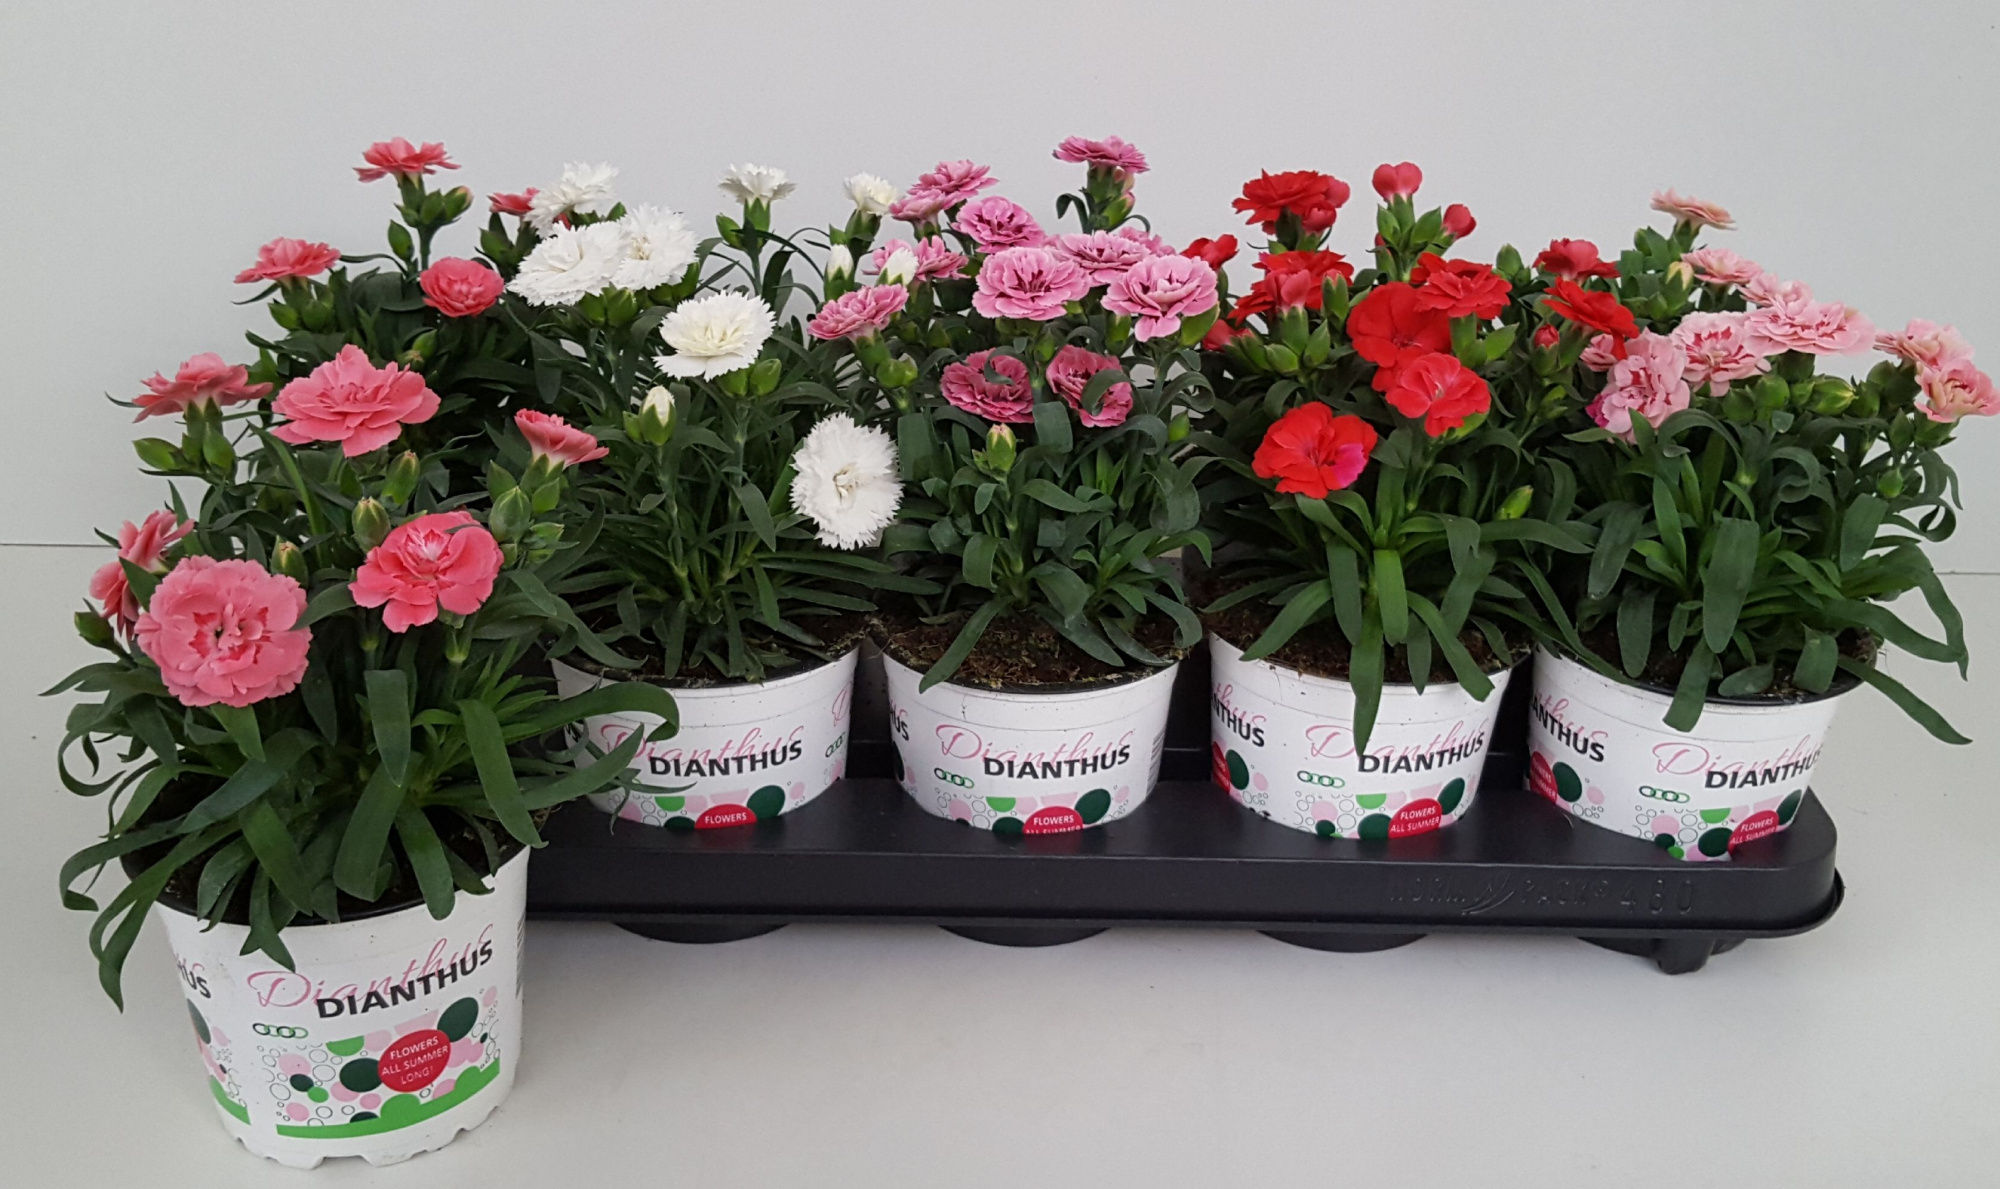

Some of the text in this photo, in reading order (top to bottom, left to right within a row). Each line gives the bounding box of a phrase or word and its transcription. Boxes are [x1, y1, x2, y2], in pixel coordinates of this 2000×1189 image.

[1212, 694, 1265, 748] NTHUS
[1531, 696, 1605, 763] ANTHUS
[935, 724, 1134, 767] Dianthus
[1305, 717, 1489, 762] Danthus
[1358, 731, 1485, 773] DIANTHUS
[650, 739, 803, 777] DIANTHUS
[984, 744, 1131, 779] DIANTHUS
[704, 811, 748, 825] FLOWERS
[1033, 814, 1074, 826] FLOWERS
[1390, 816, 1440, 833] ALL SUMMER
[1400, 806, 1436, 820] FLOWERS
[1740, 817, 1775, 832] FLOWERS
[1730, 835, 1743, 844] ALL
[247, 924, 494, 1008] Dianthus
[316, 939, 493, 1019] DIANTHUS
[381, 1045, 449, 1076] ALL SUMMER
[390, 1036, 439, 1060] FLOWERS
